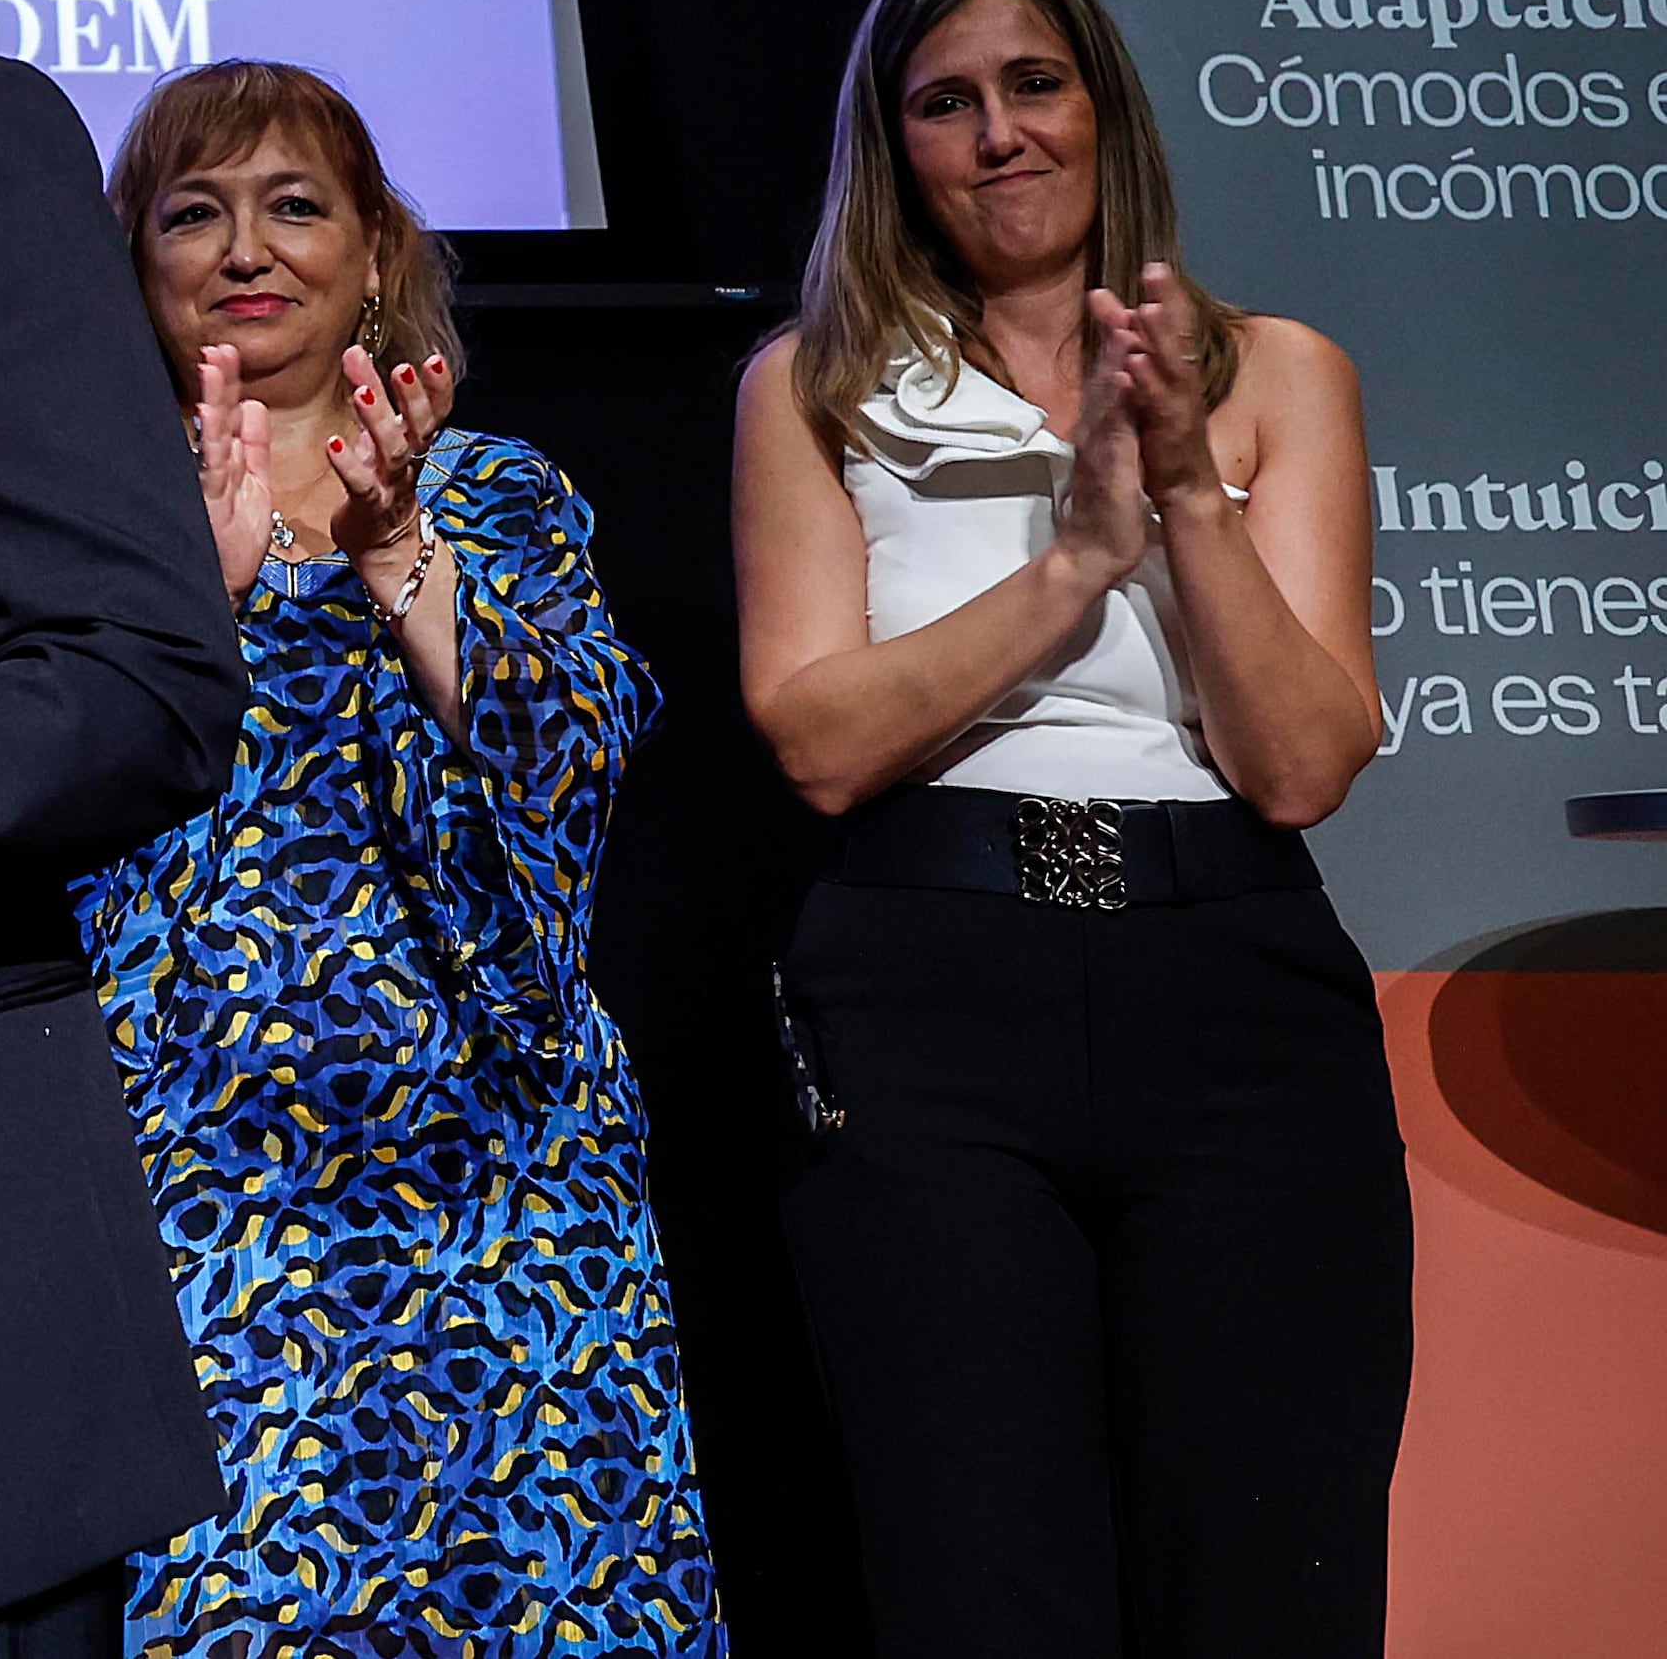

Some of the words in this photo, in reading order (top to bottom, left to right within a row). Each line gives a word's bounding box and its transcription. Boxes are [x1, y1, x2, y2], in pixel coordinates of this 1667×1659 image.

[1199, 53, 1629, 127] Cómodos
[1376, 675, 1473, 756] ya
[1492, 675, 1601, 735] es
[1613, 665, 1667, 734] t
